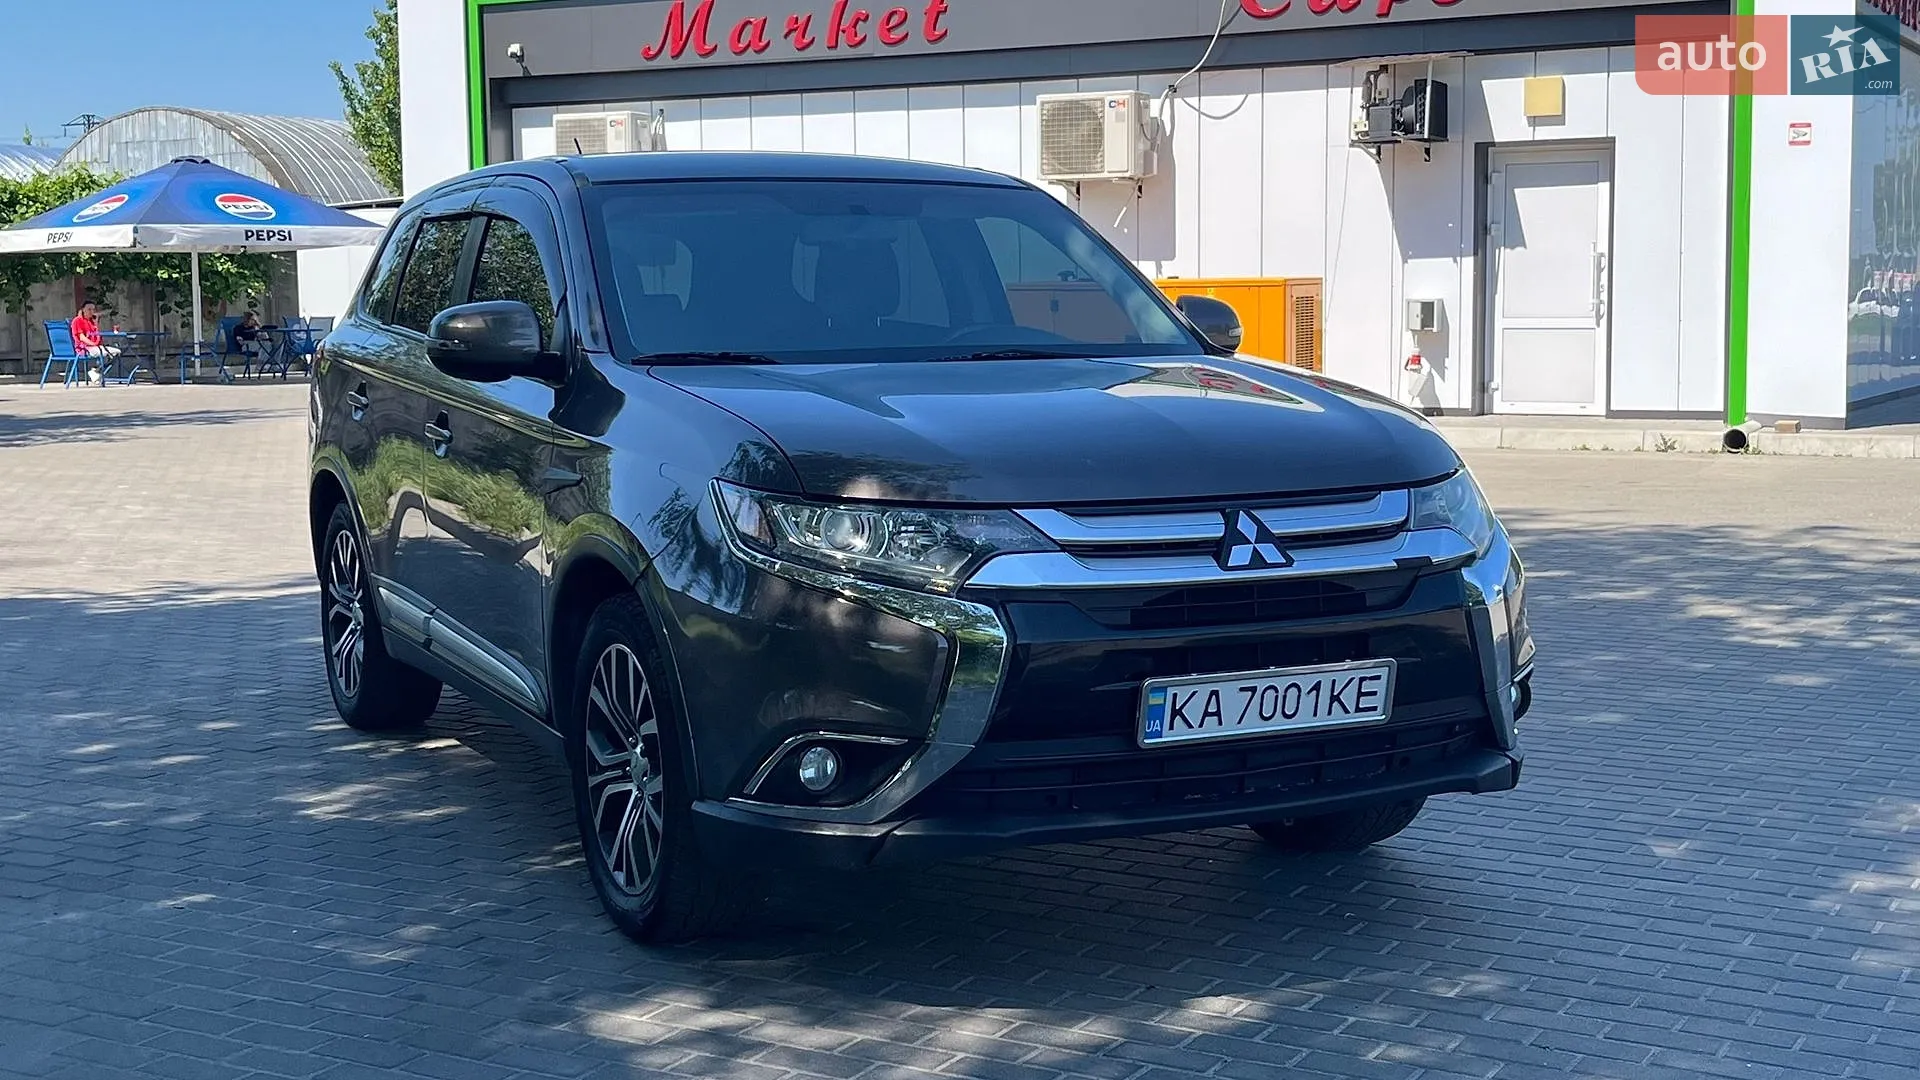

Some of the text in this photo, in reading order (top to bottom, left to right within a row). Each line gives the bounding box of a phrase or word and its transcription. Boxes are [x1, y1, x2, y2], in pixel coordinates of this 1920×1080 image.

[640, 0, 948, 60] Market
[1108, 100, 1126, 109] CH
[221, 203, 270, 211] PEPSI
[47, 231, 74, 244] PEPSI
[244, 229, 293, 241] PEPSI
[1145, 720, 1161, 732] UA
